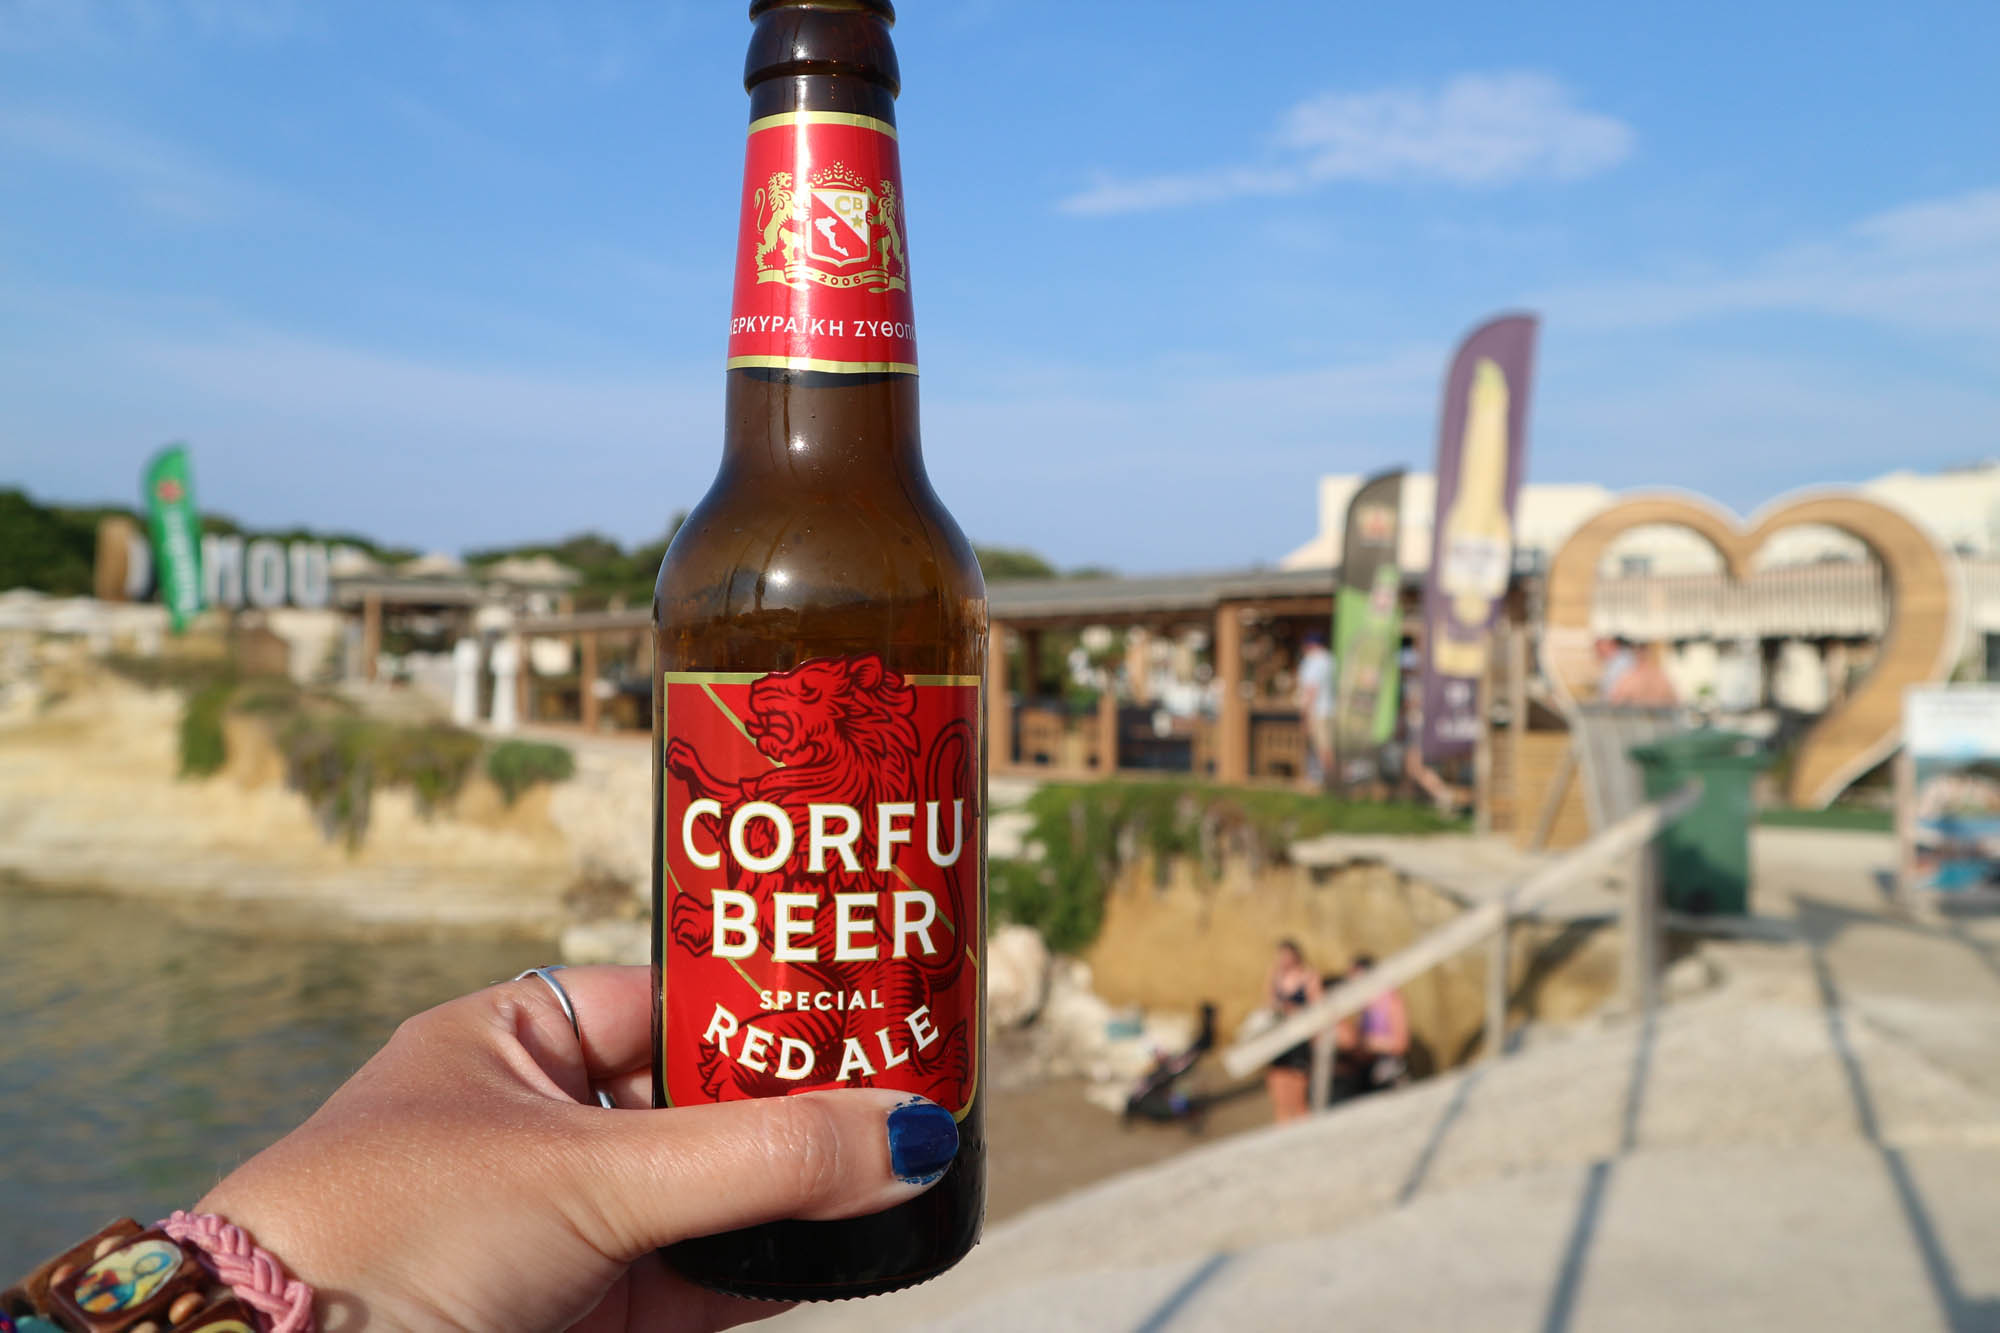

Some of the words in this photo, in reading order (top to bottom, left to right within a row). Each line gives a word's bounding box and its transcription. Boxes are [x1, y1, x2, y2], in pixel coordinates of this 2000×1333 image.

[818, 273, 862, 286] 2006
[681, 797, 964, 873] CORFU
[710, 889, 938, 963] BEER
[759, 990, 884, 1011] SPECIAL
[702, 1002, 815, 1081] RED
[835, 1005, 941, 1082] ALE
